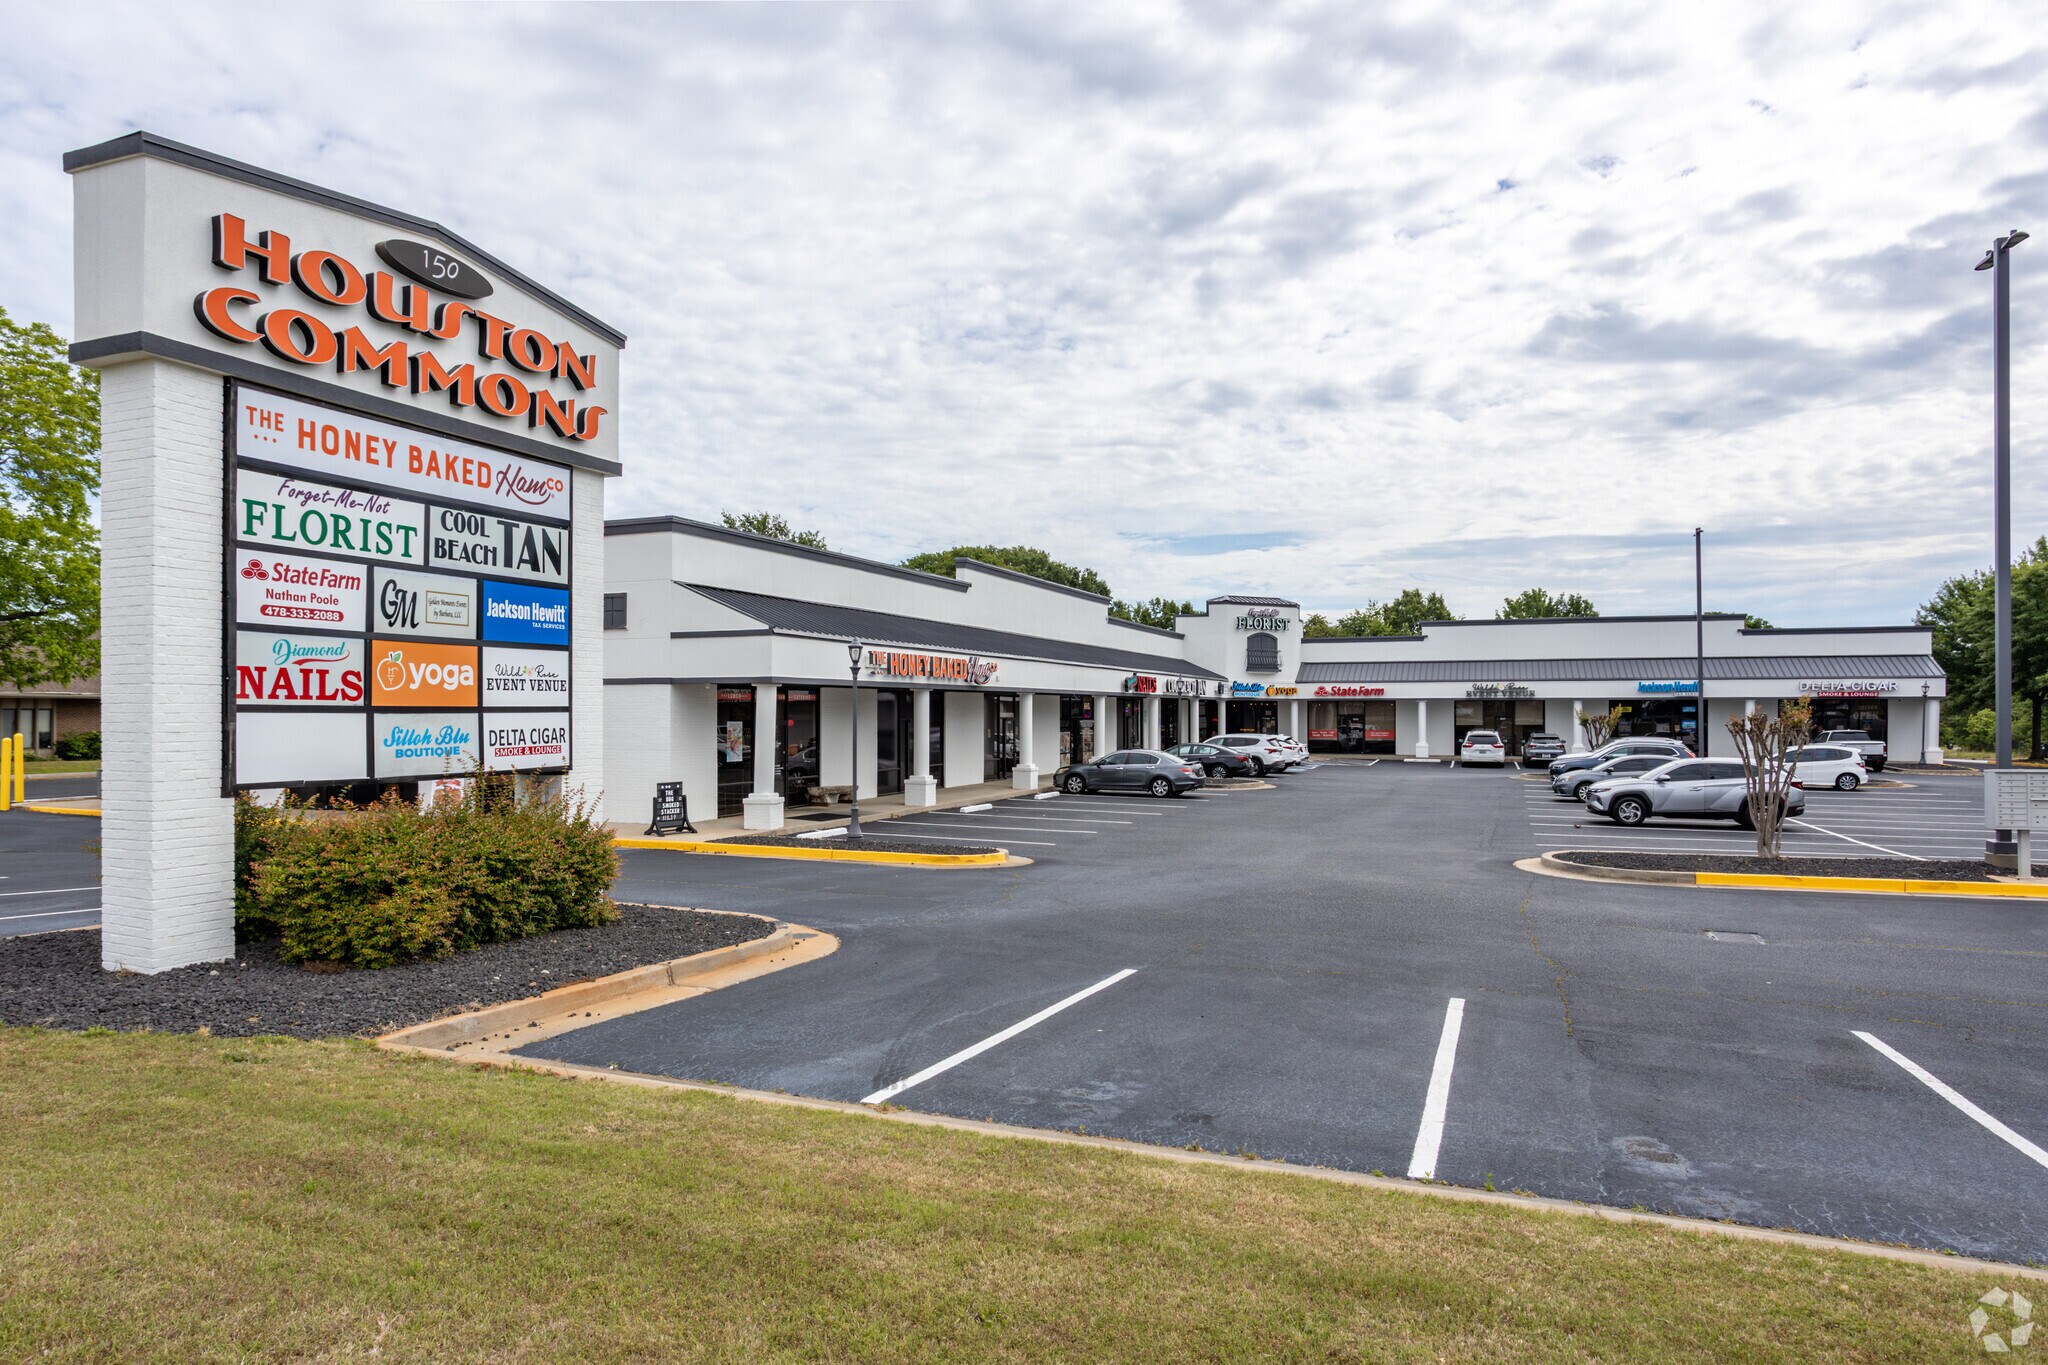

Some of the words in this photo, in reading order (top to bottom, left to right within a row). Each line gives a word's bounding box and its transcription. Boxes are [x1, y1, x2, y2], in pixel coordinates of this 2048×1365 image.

[423, 249, 459, 279] 150
[212, 213, 597, 390] HOUSTON
[194, 287, 608, 440] COMMONS
[246, 405, 285, 432] THE
[298, 417, 397, 469] HONEY
[408, 445, 491, 489] BAKED
[277, 479, 390, 514] Forget-Me-Not
[242, 498, 417, 558] FLORIST
[440, 510, 490, 538] COOL
[434, 537, 497, 567] BEACH
[497, 519, 562, 576] TAN
[265, 588, 306, 603] Nathan
[310, 593, 339, 605] Poole
[265, 606, 340, 621] 478-333-2088
[486, 597, 530, 620] Jackson
[532, 602, 566, 623] Hewitt
[1237, 616, 1291, 631] FLORIST
[272, 639, 345, 665] Diamond
[408, 662, 474, 691] yoga
[495, 664, 523, 677] Wild
[535, 664, 559, 678] Rose
[868, 651, 887, 665] THE
[887, 652, 931, 677] HONEY
[932, 656, 967, 680] BAKED
[237, 665, 363, 702] NAILS
[486, 678, 526, 691] EVENT
[530, 679, 567, 692] VENUE
[1137, 675, 1157, 693] NAILS
[1276, 687, 1297, 695] yoga
[1638, 681, 1673, 692] Jackson
[1799, 681, 1847, 691] DELTA
[1851, 681, 1898, 691] CIGAR
[435, 725, 470, 745] Blu
[489, 729, 527, 747] DELTA
[530, 728, 566, 744] CIGAR
[395, 746, 460, 758] BOUTIQUE
[495, 747, 523, 757] SMOKE
[524, 746, 531, 755] &
[532, 745, 561, 755] LOUNGE
